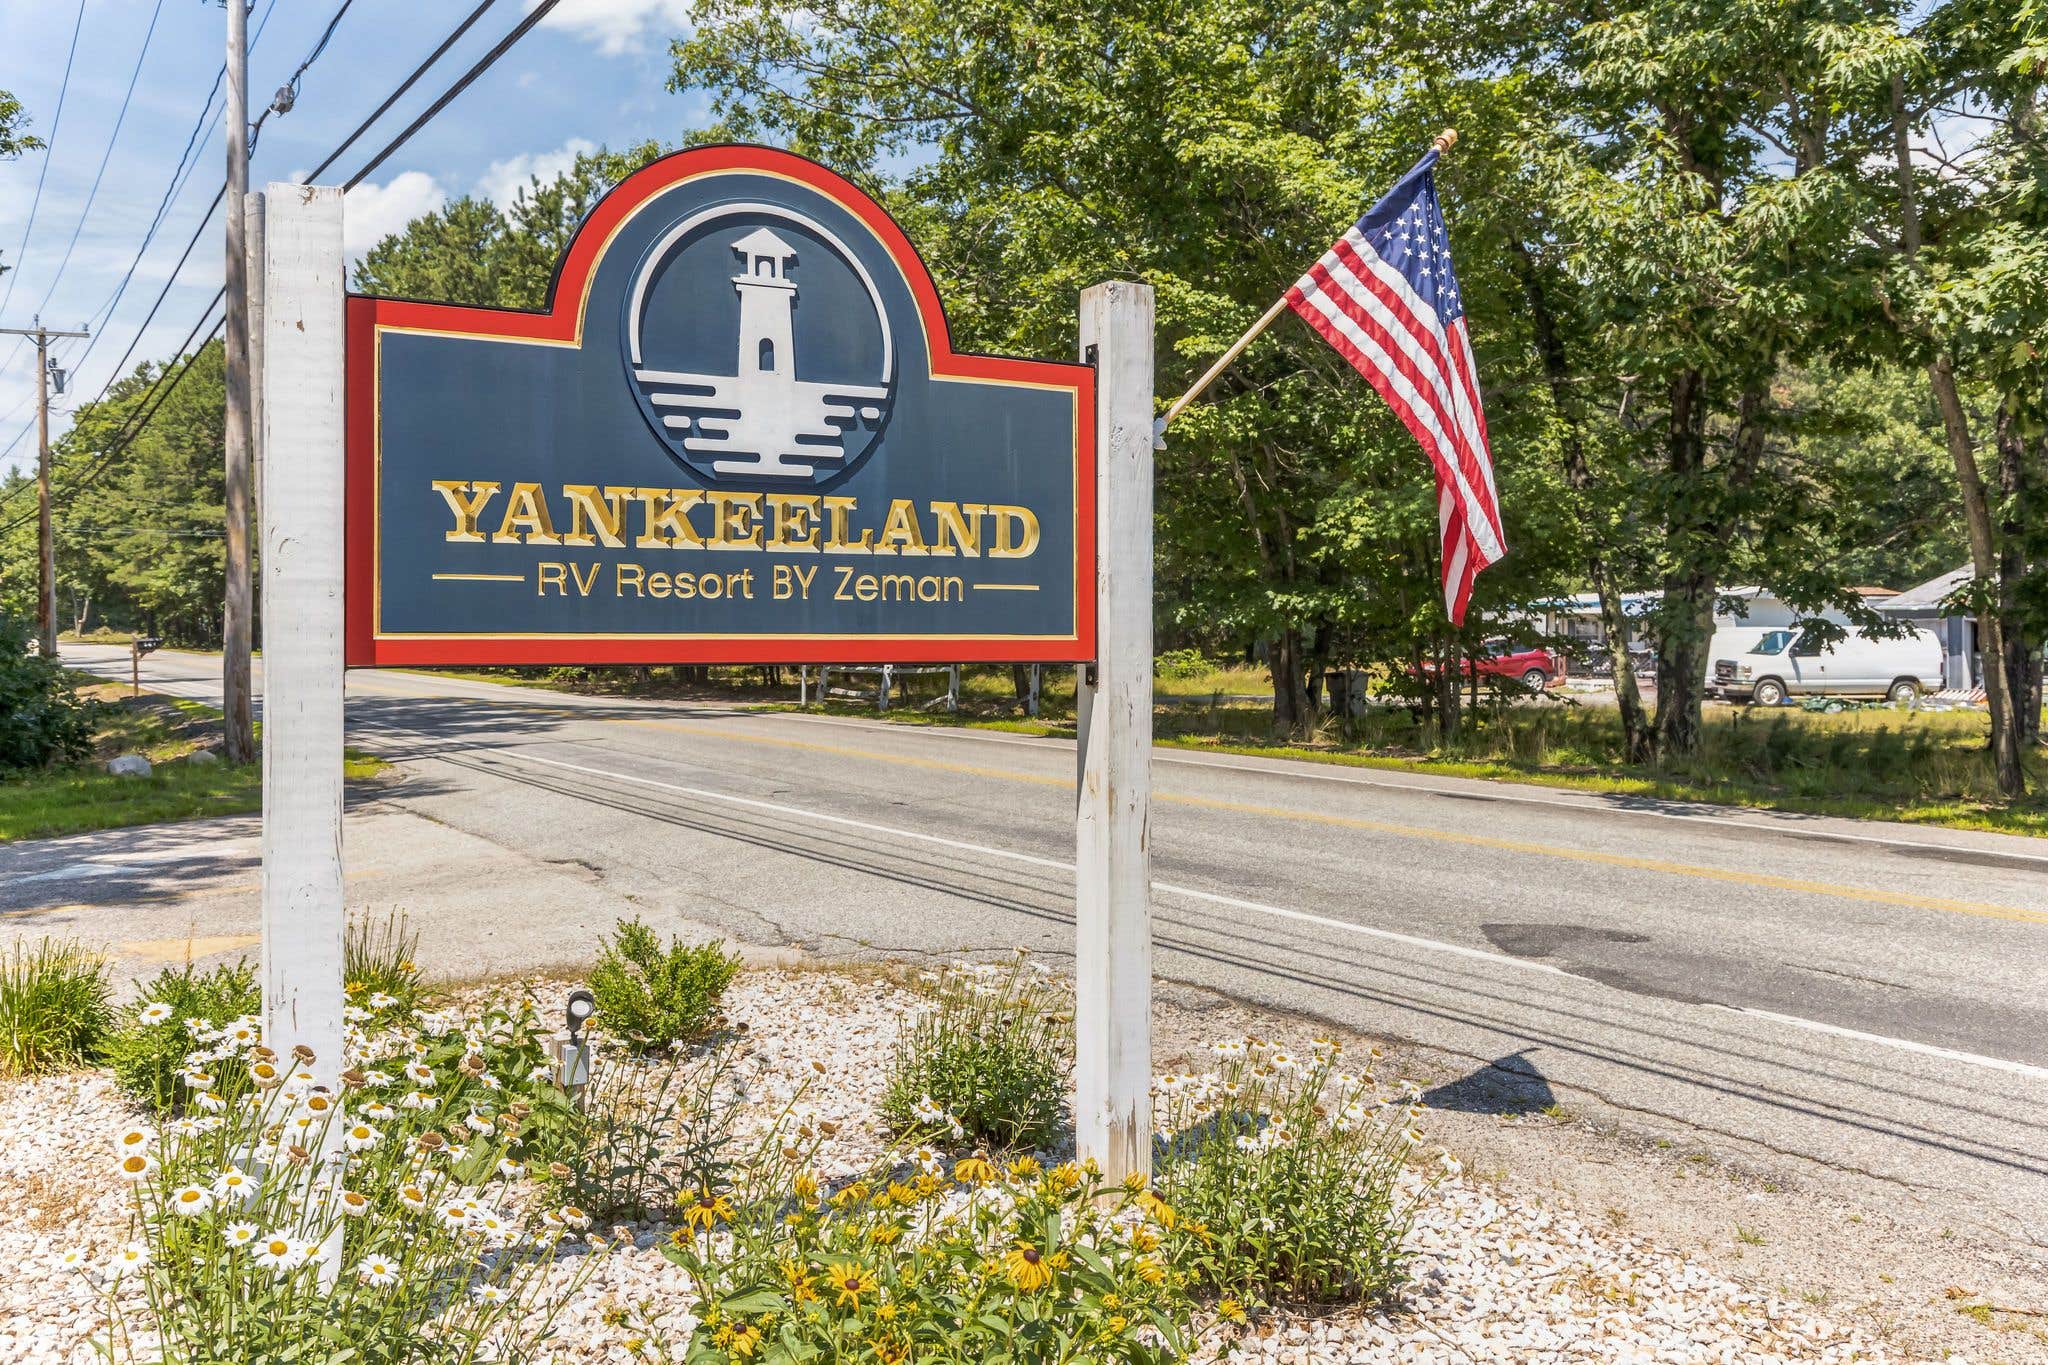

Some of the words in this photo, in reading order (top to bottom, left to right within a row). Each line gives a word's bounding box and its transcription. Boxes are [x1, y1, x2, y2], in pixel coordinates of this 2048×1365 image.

[431, 480, 1041, 559] YANKEELAND
[538, 562, 602, 597] RV
[616, 563, 754, 600] Resort
[773, 564, 818, 601] BY
[834, 566, 964, 602] Zeman
